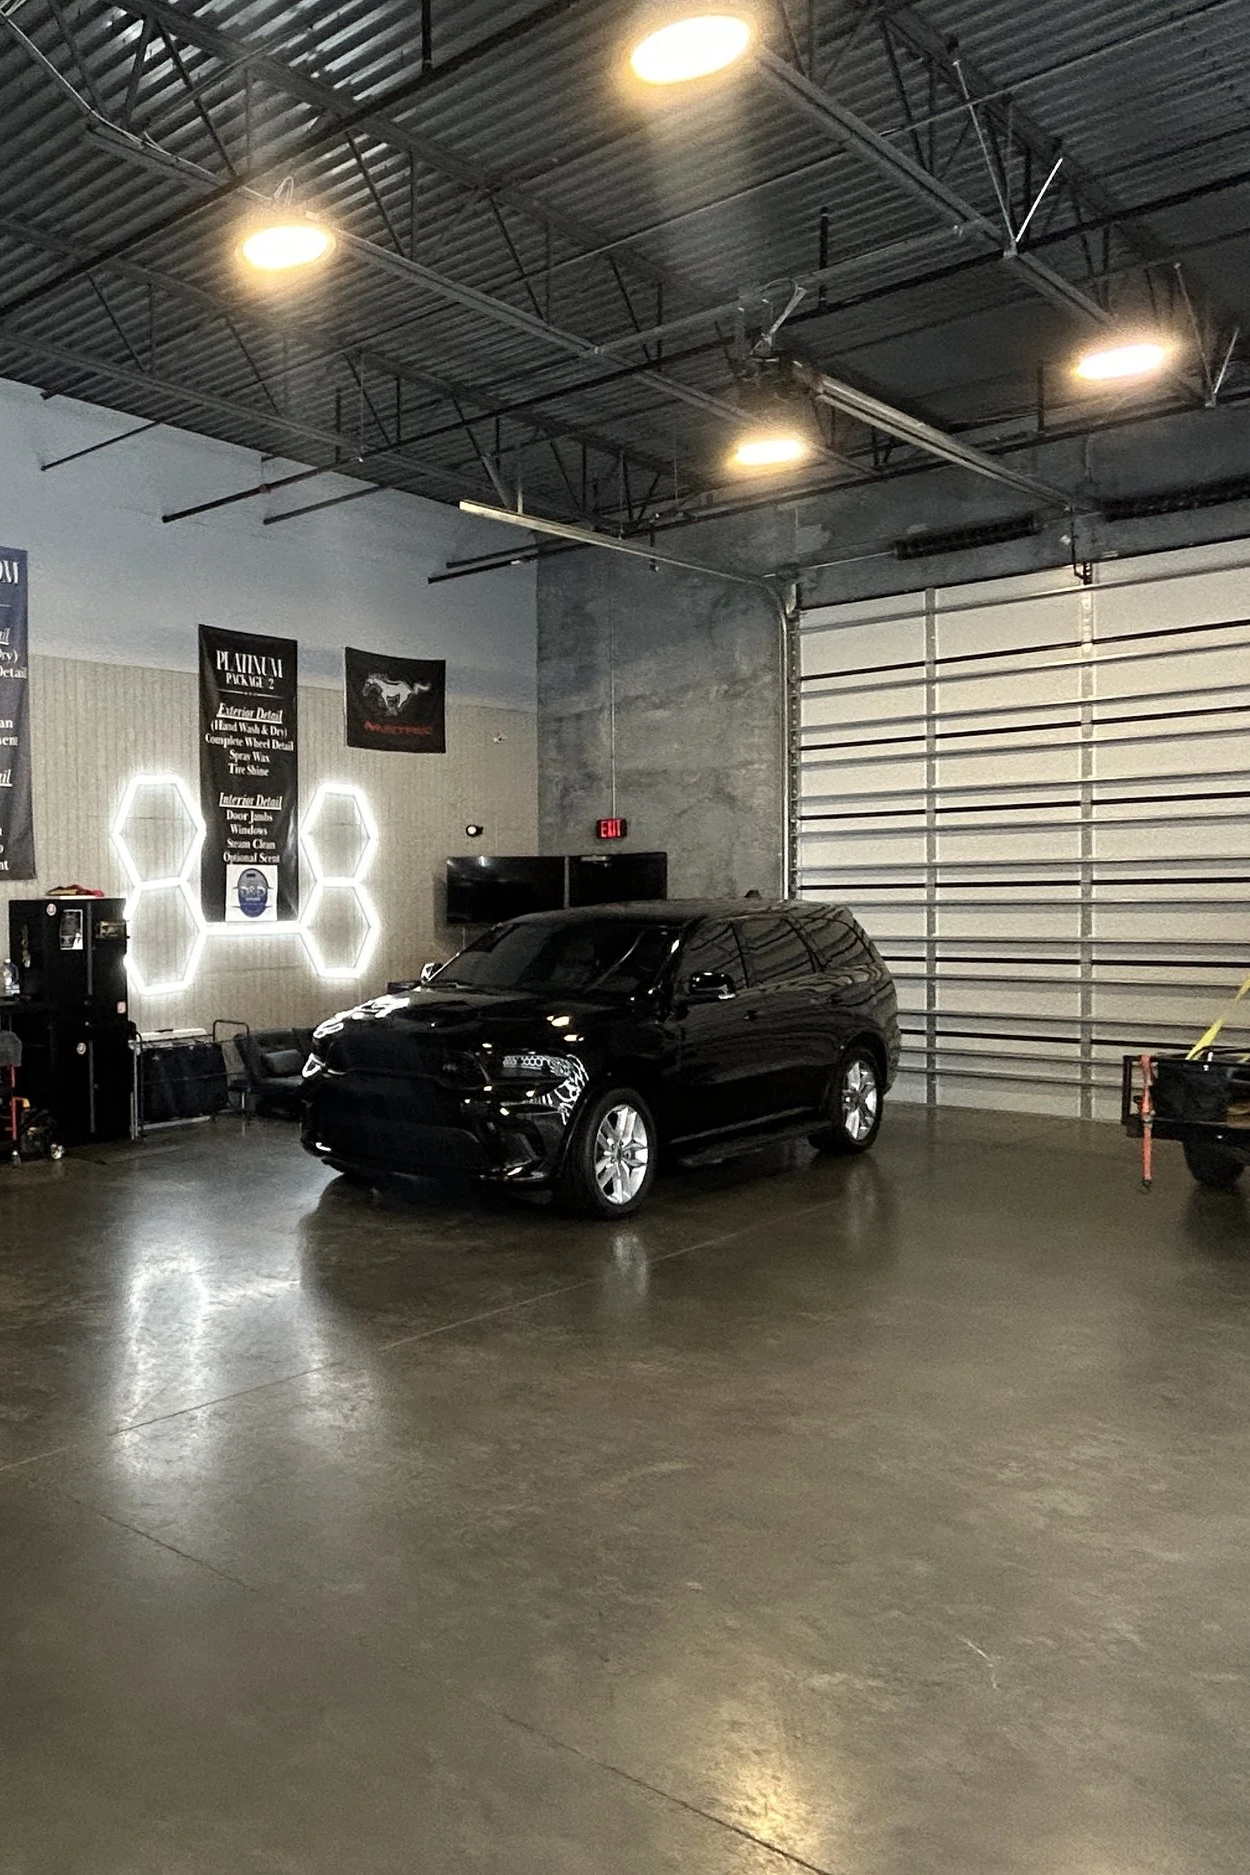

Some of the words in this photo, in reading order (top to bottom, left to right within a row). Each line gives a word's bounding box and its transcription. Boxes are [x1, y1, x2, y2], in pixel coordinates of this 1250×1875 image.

[218, 702, 255, 719] Exterior
[256, 707, 283, 722] Detail
[210, 719, 238, 732] (Hand
[238, 722, 261, 735] Wash
[261, 724, 269, 736] &
[270, 725, 288, 739] Dry)
[205, 732, 244, 749] Complete
[245, 736, 271, 749] Wheel
[272, 739, 294, 751] Detail
[229, 749, 251, 763] Spray
[252, 751, 270, 763] Wax
[228, 763, 245, 775] Tire
[247, 764, 270, 777] Shine
[219, 792, 255, 807] Interior
[256, 794, 282, 808] Detail
[226, 810, 249, 821] Door
[249, 811, 273, 824] Jambs
[230, 824, 268, 835] Windows
[600, 819, 621, 838] EXIT
[227, 838, 251, 849] Steam
[252, 838, 276, 850] Clean
[223, 852, 257, 866] Optional
[259, 853, 281, 864] Scent
